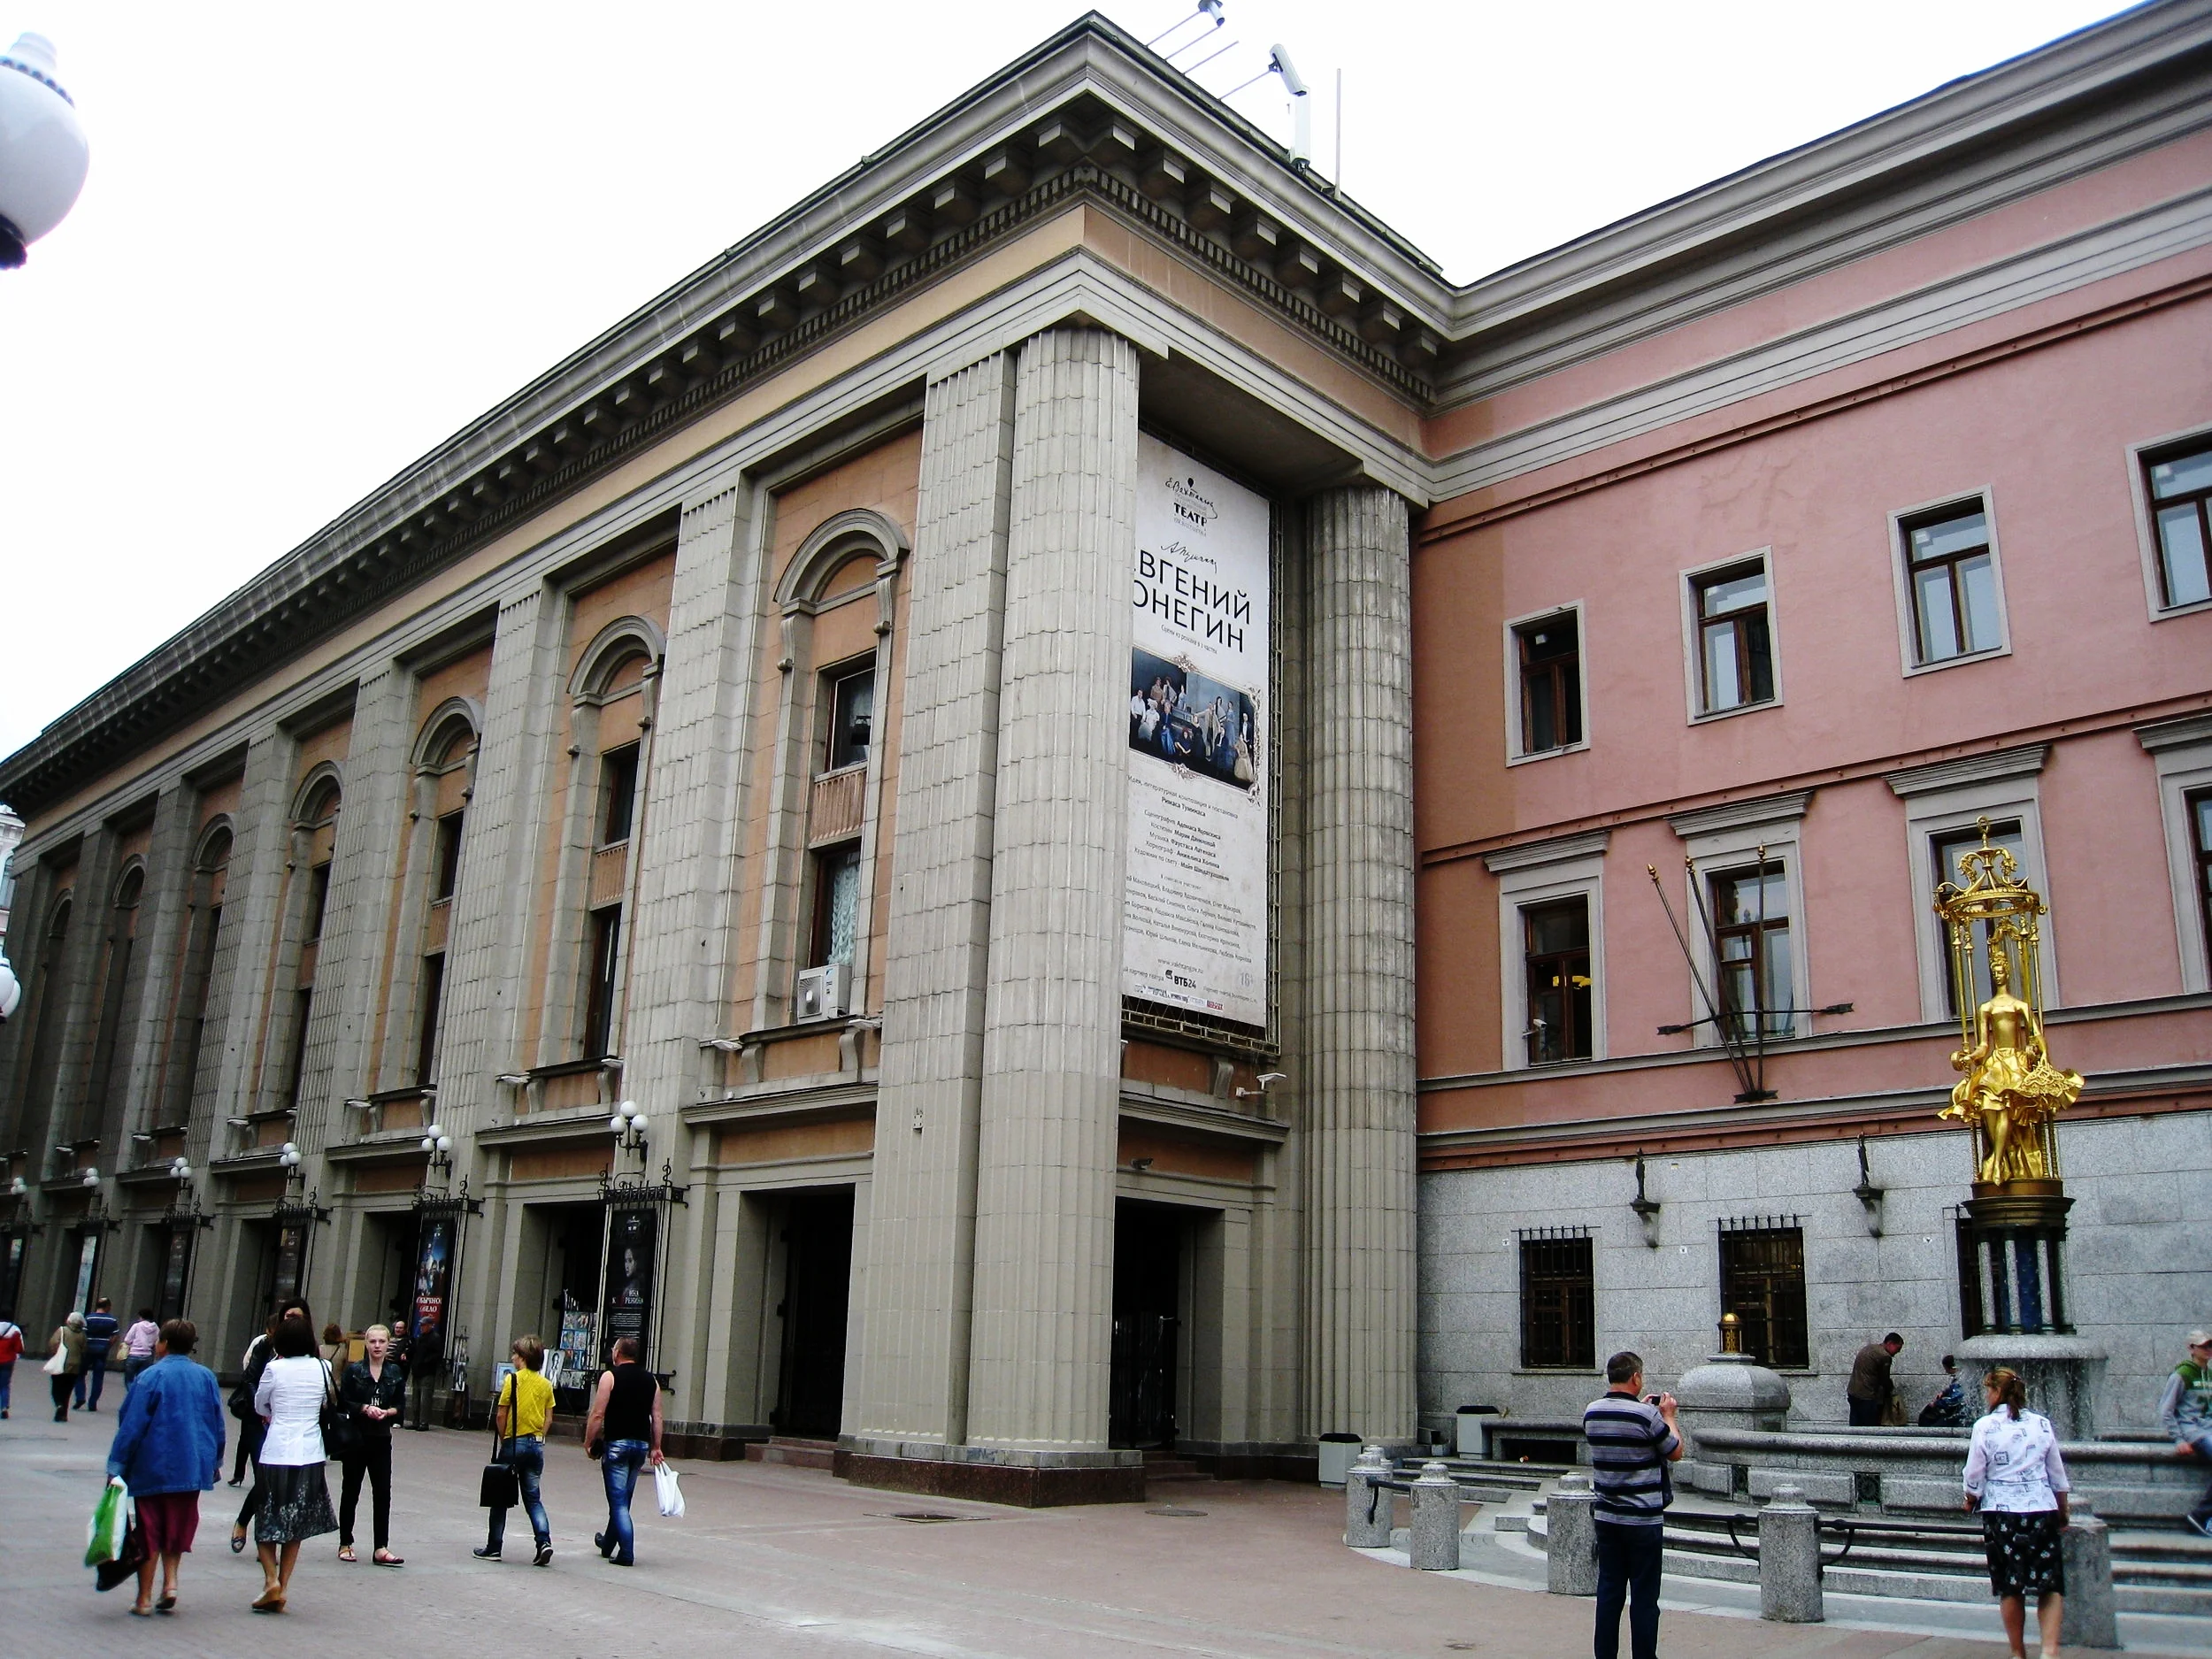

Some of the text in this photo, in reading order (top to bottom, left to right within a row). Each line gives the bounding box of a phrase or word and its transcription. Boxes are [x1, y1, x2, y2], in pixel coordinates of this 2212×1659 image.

[1173, 503, 1208, 526] ТЕАТР
[1133, 549, 1250, 625] ВГЕНИЙ
[1133, 580, 1243, 653] ОНЕГИН
[1173, 975, 1196, 989] ВТБ24
